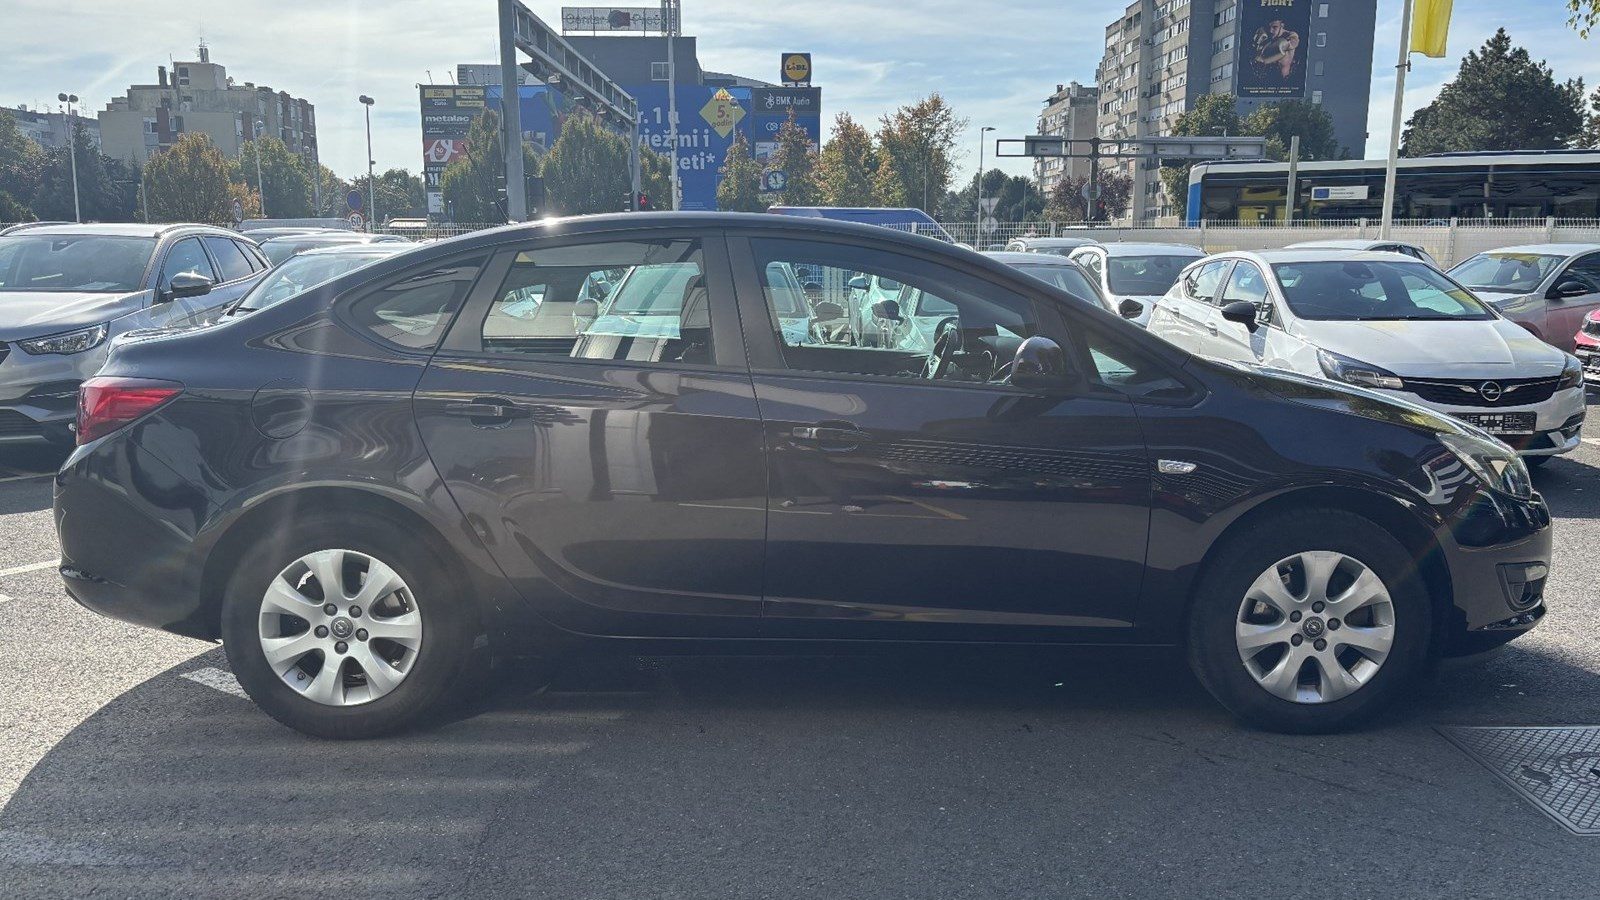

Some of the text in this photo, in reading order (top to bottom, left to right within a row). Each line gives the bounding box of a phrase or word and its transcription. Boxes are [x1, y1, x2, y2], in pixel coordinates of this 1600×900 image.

[775, 96, 810, 105] BMK Audio
[652, 107, 661, 123] 1
[717, 104, 730, 119] 5.
